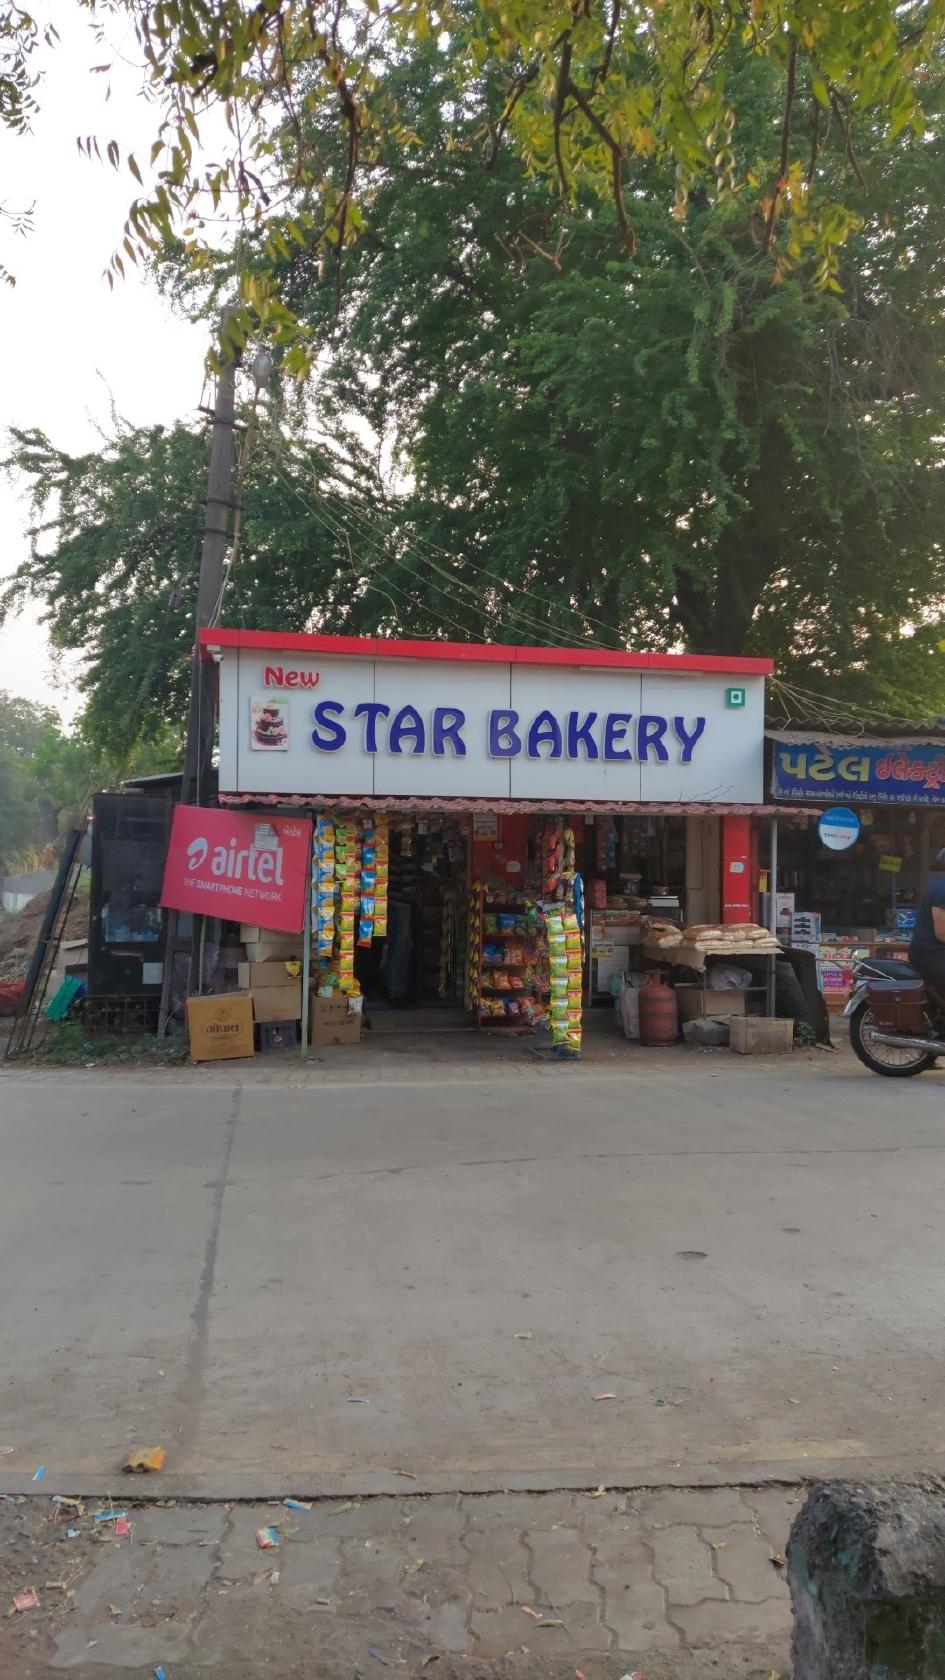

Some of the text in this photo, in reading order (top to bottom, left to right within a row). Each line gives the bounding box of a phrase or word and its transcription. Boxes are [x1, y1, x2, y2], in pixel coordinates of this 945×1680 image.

[263, 665, 320, 688] New
[311, 700, 706, 764] STAR BAKERY
[779, 749, 871, 782] પટેલ
[211, 837, 284, 886] airtel
[183, 877, 282, 902] THE SMARTPHONE NETWORK
